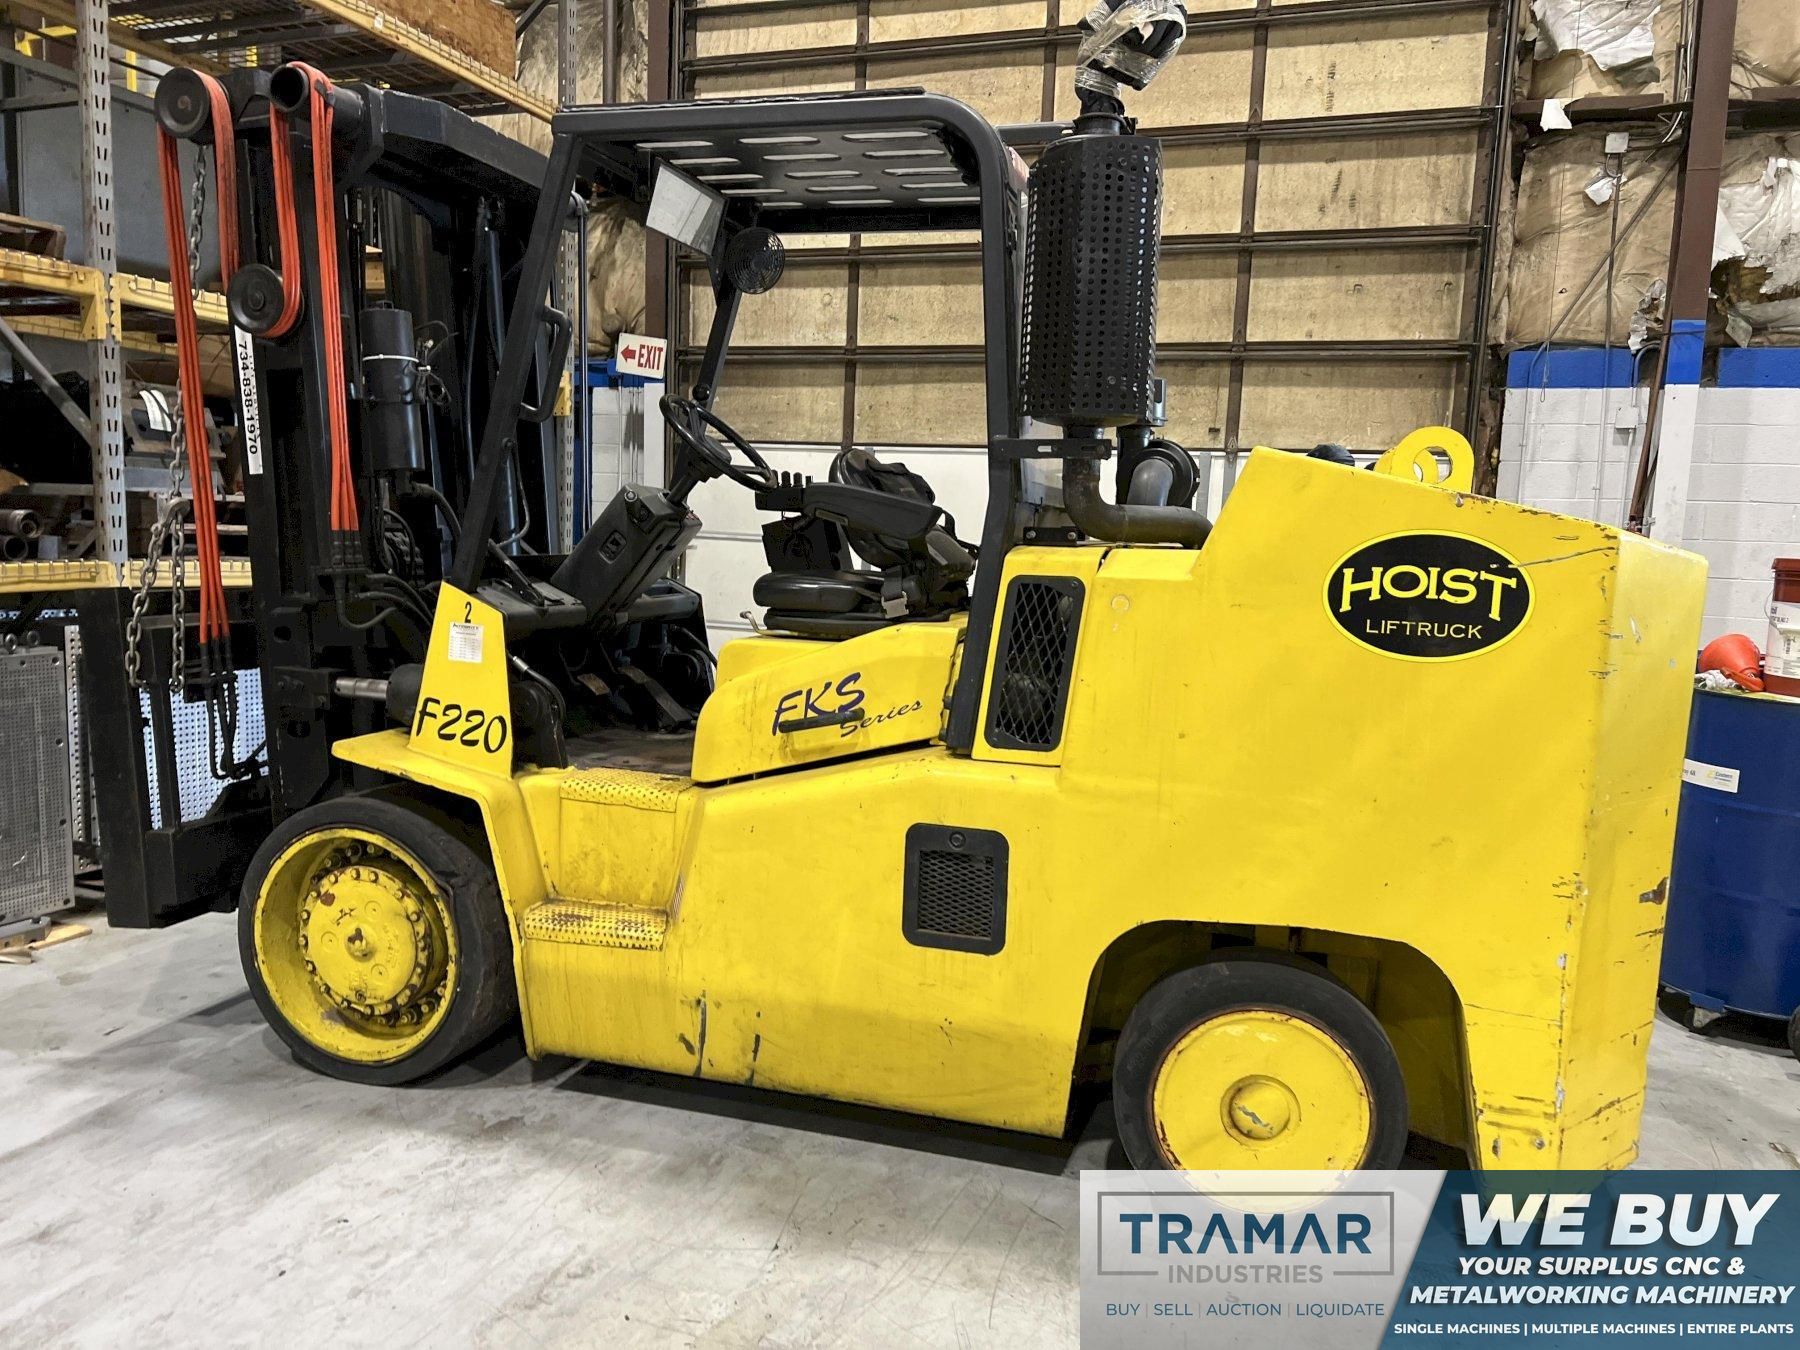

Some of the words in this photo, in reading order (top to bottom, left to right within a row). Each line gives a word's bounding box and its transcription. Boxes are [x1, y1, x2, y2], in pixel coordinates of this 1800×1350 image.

[637, 343, 664, 371] EXIT
[238, 341, 258, 455] 734-838-1970
[464, 601, 472, 624] 2
[1339, 564, 1517, 621] HOIST
[1366, 619, 1483, 640] LIFTRUCK
[416, 696, 508, 754] F220
[771, 672, 865, 736] FKS
[839, 700, 923, 738] Series
